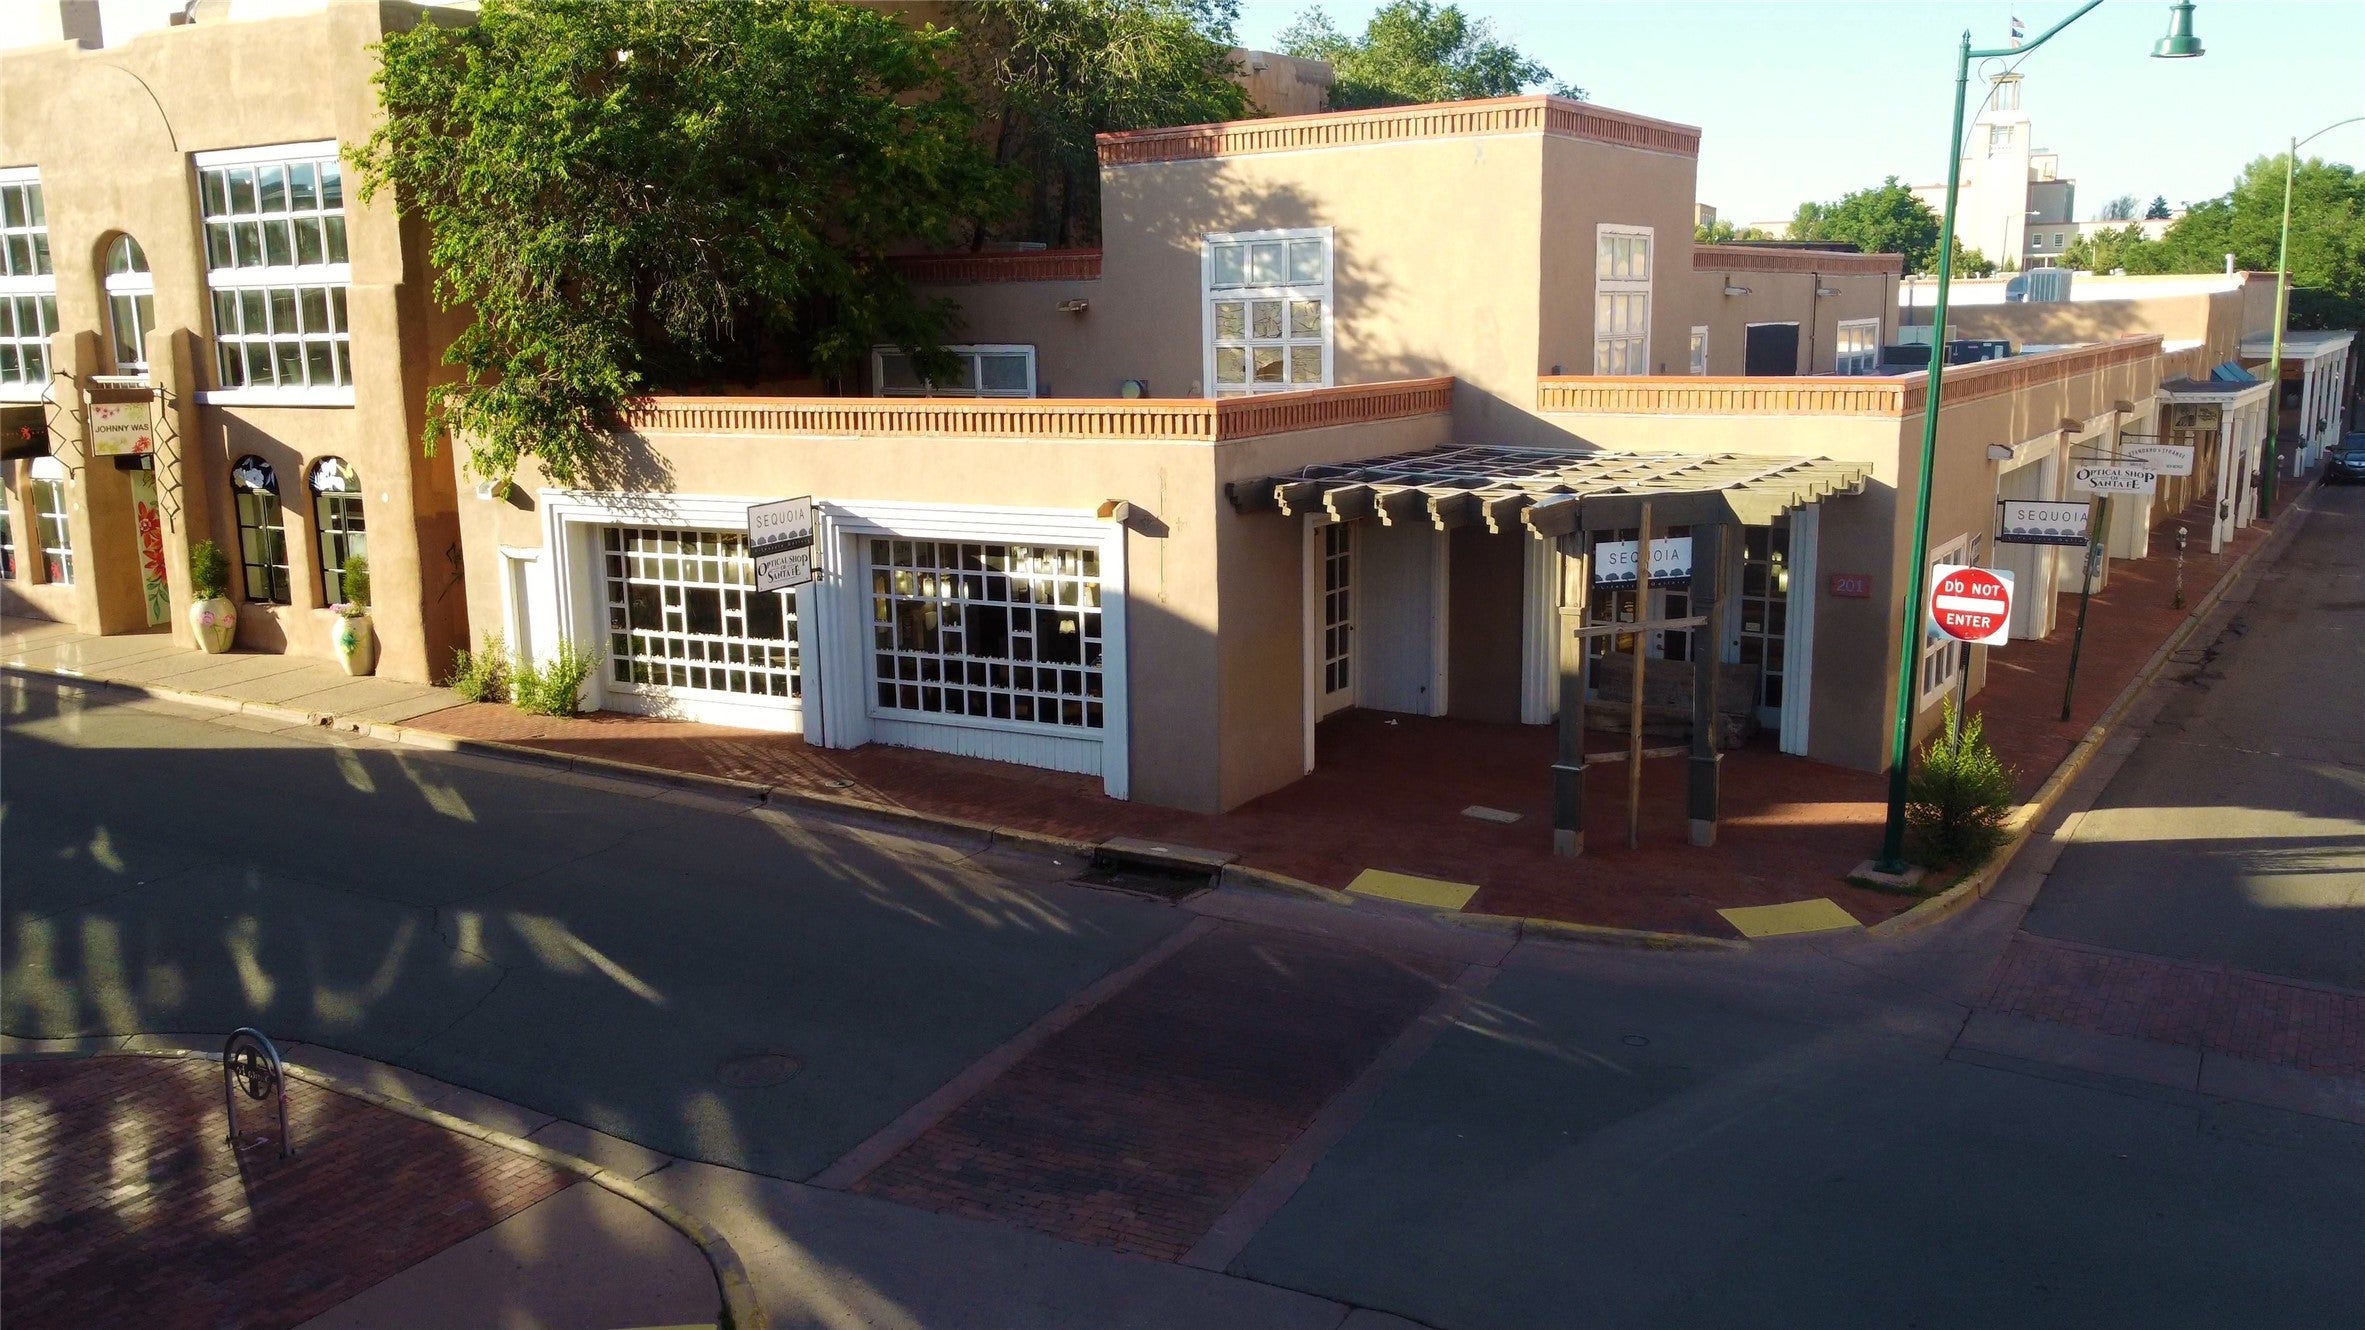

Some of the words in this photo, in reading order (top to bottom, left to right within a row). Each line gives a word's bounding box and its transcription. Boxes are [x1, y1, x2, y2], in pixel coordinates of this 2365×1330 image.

[95, 424, 129, 433] JOHNNY
[131, 423, 149, 431] WAS
[756, 509, 804, 528] SEQUOIA
[2018, 509, 2088, 522] SEQUOIA
[1609, 549, 1679, 564] SEQOIA
[1837, 578, 1863, 593] 201
[1945, 580, 1964, 593] DO
[1971, 583, 2000, 597] NOT
[1946, 612, 1991, 629] ENTER
